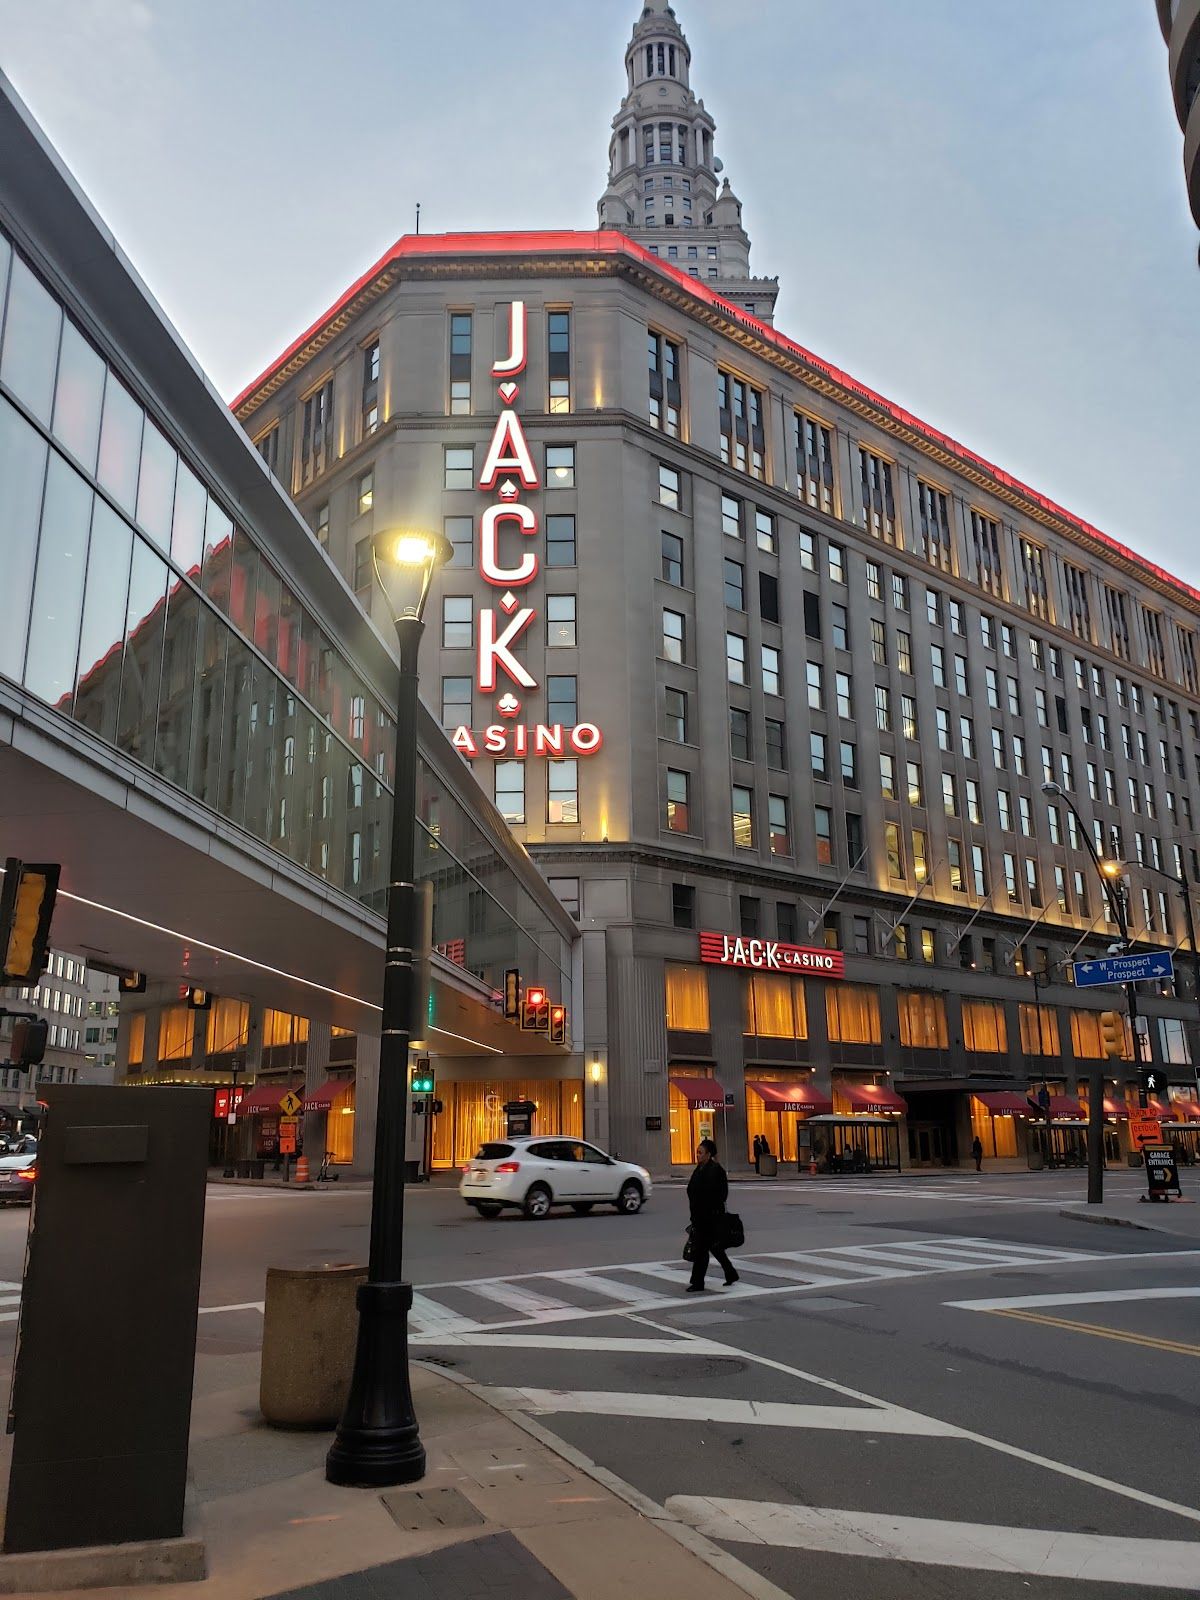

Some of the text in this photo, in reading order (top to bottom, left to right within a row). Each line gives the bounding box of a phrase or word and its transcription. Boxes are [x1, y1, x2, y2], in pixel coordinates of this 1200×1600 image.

[479, 300, 539, 693] JACK
[452, 723, 602, 757] ASINO
[720, 935, 834, 969] JACK CASINO
[1099, 957, 1151, 971] W. Prospect
[1107, 967, 1146, 980] Prospect
[694, 1099, 714, 1109] JACK
[784, 1102, 801, 1111] JACK
[867, 1103, 882, 1112] JACK
[1150, 1151, 1171, 1159] GARAGE
